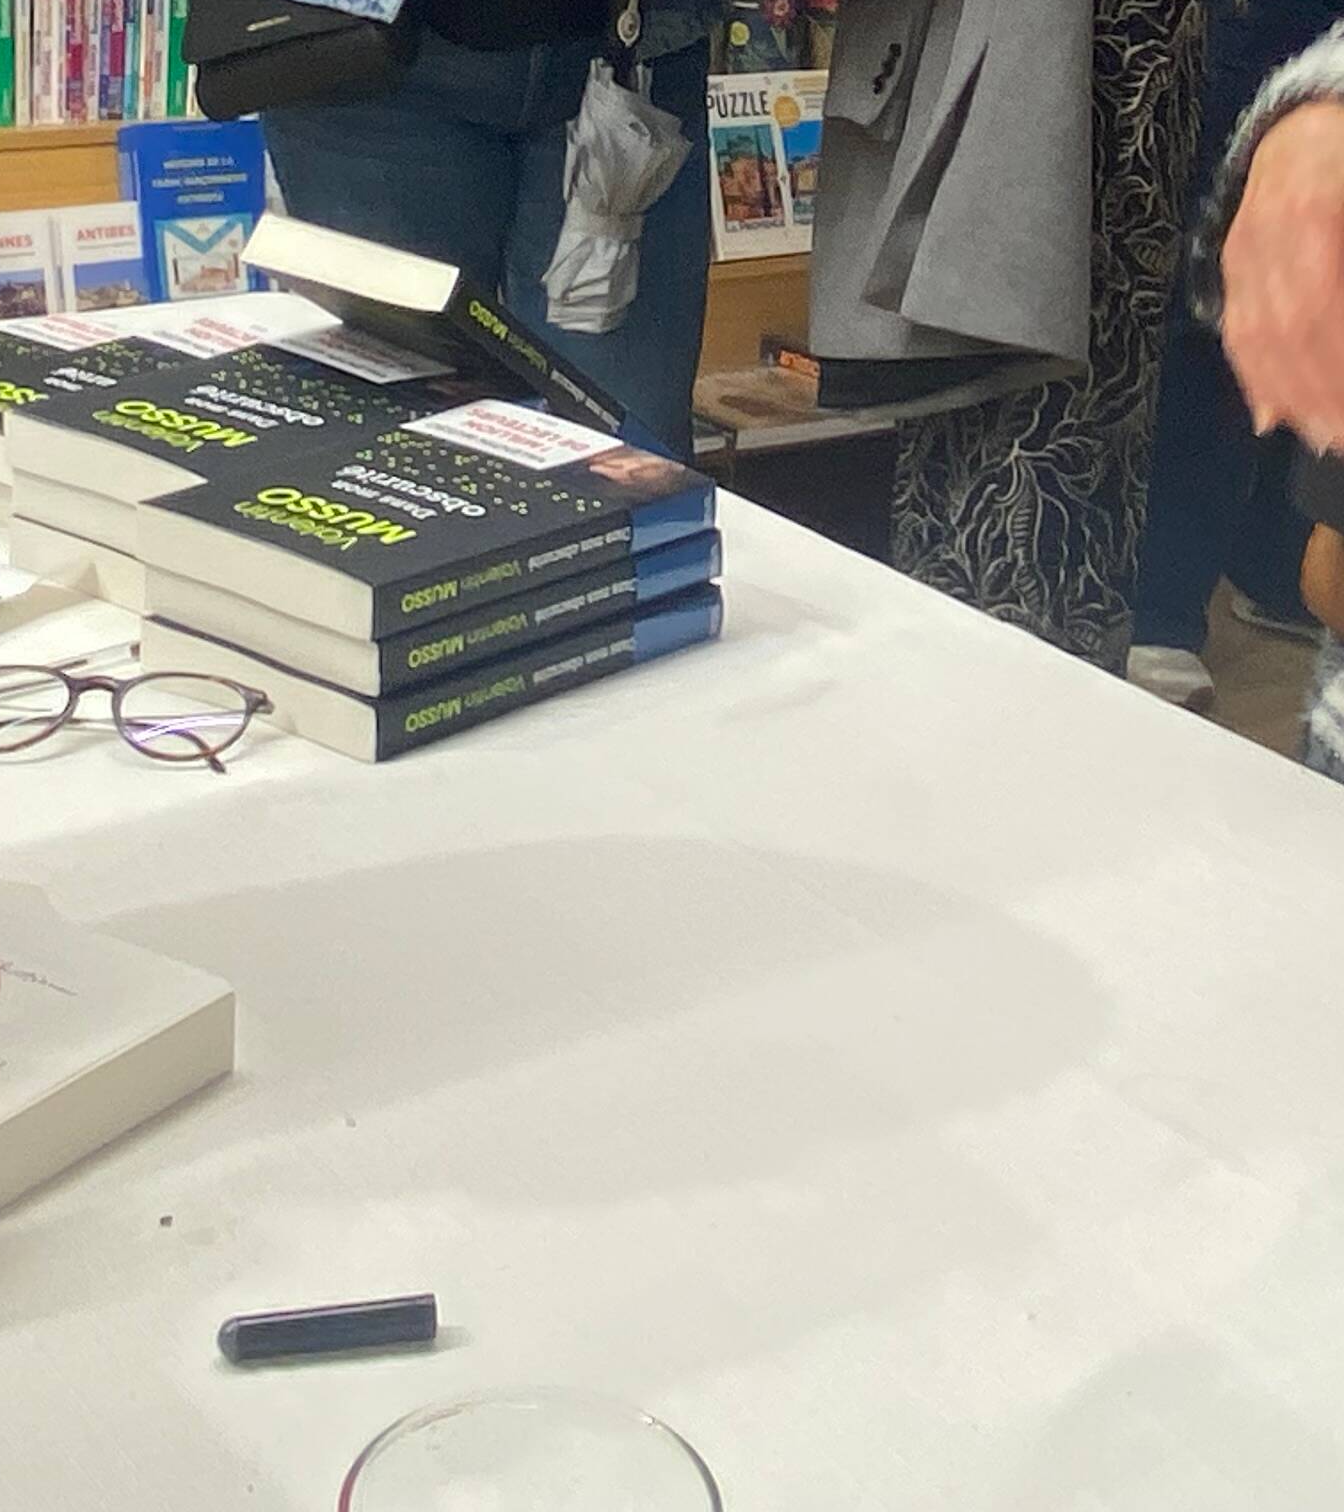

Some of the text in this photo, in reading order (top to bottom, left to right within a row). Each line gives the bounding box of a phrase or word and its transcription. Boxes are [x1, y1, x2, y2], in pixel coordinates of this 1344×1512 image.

[706, 90, 771, 119] PUZZLE
[76, 224, 136, 242] ANTIBES
[469, 300, 508, 340] MUSSO
[114, 399, 258, 449] MUSSO
[184, 396, 281, 430] Dans mon
[192, 384, 326, 428] obscurité
[92, 410, 205, 454] Valentin
[330, 479, 440, 521] Dans mon
[335, 464, 488, 519] obscurité
[233, 500, 357, 551] Valentin
[256, 486, 418, 546] MUSSO
[460, 560, 522, 590] Valentin
[401, 580, 459, 613] MUSSO
[466, 613, 528, 646] Valentin
[408, 636, 464, 669] MUSSO
[463, 675, 526, 709] Valentin
[405, 697, 462, 733] MUSSO
